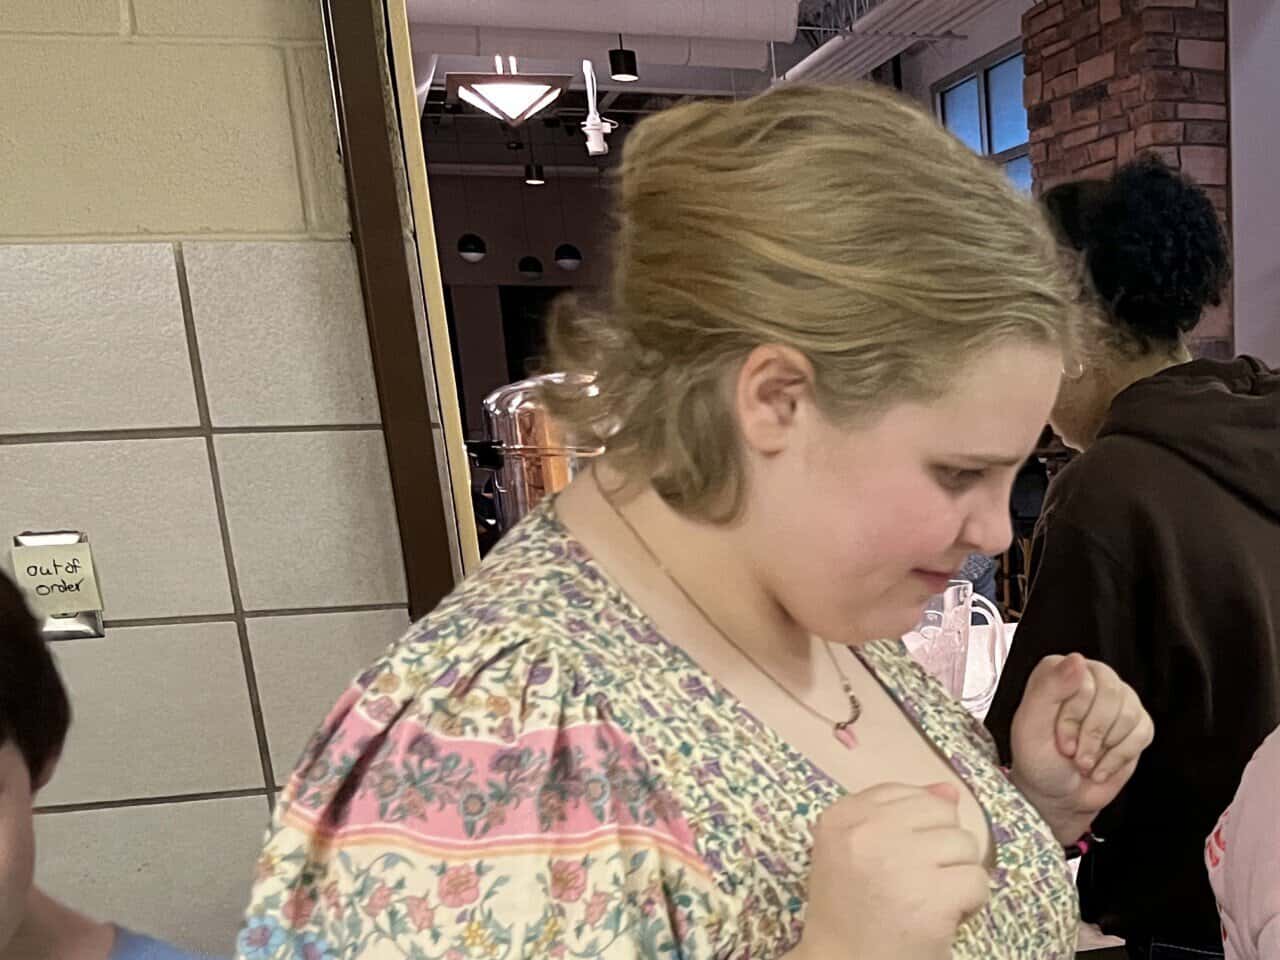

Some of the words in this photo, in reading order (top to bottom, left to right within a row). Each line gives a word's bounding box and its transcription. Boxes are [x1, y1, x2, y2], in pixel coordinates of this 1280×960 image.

[26, 558, 62, 576] out
[64, 558, 82, 574] of
[35, 578, 85, 596] order
